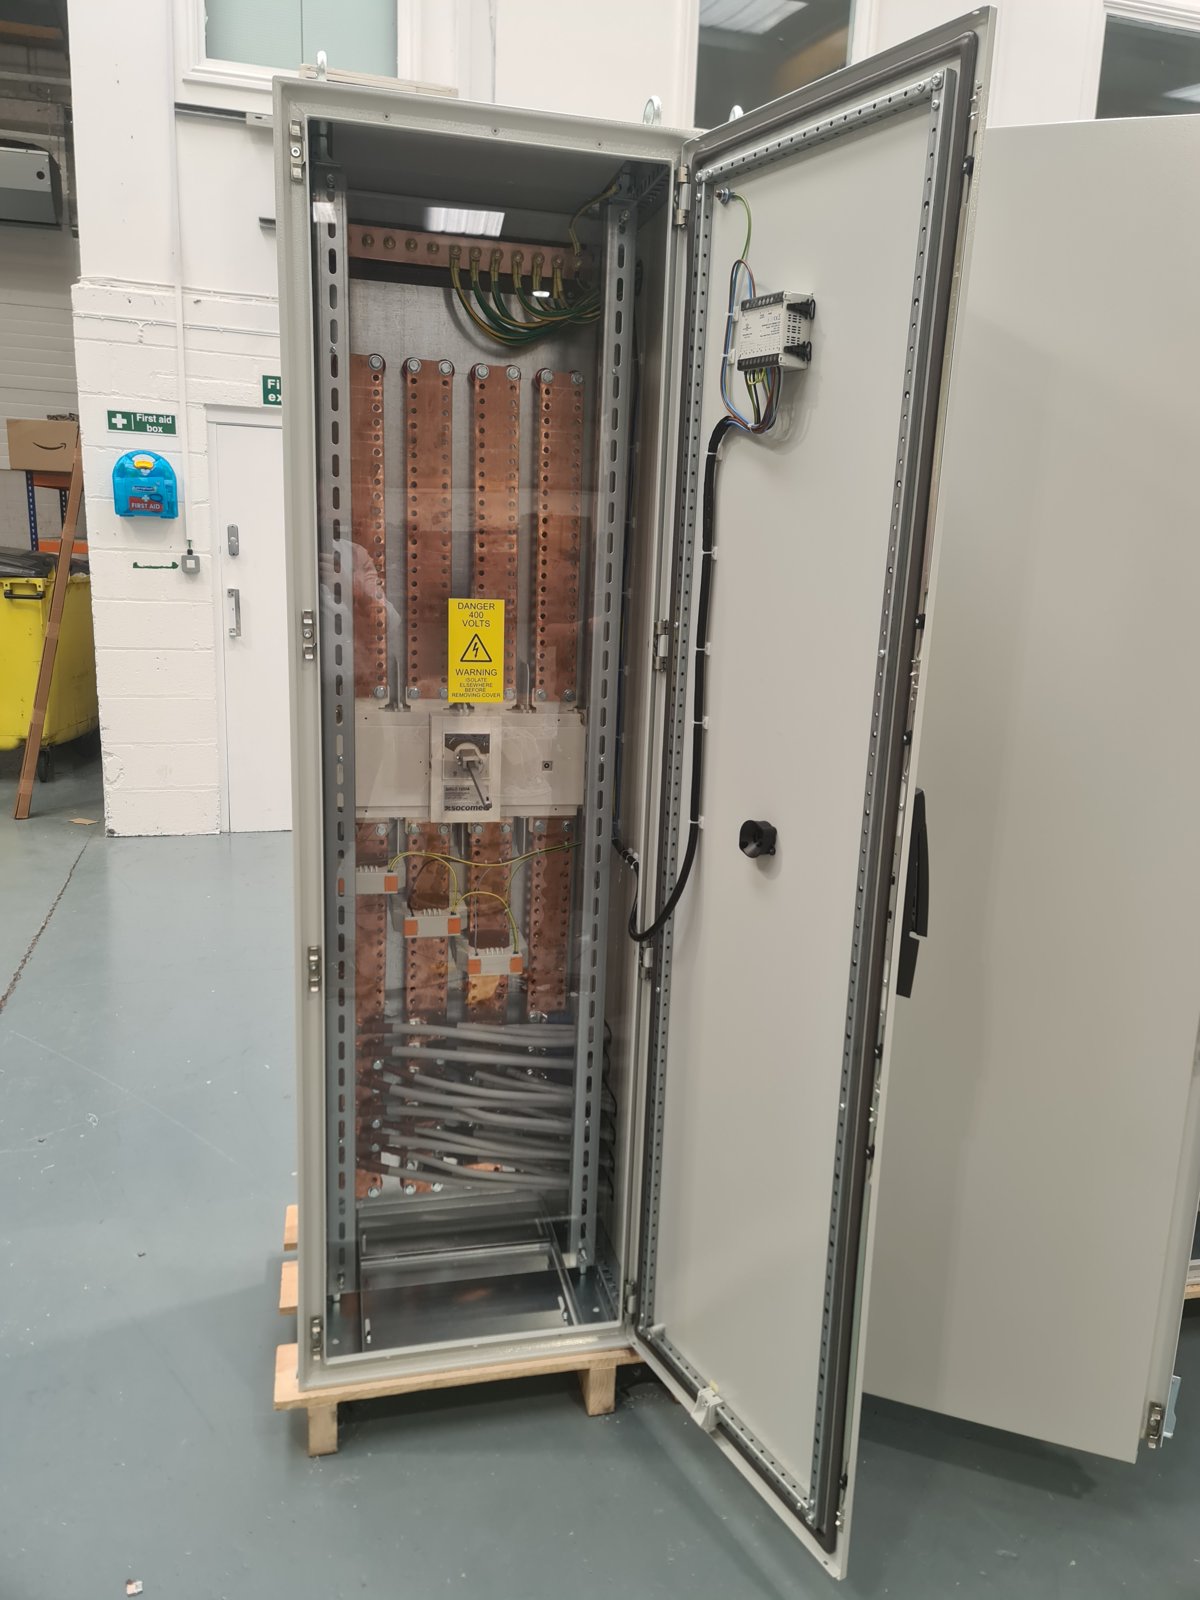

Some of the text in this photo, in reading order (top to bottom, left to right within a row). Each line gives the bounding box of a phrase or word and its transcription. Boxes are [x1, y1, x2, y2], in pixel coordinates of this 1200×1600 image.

[136, 413, 172, 424] First aid
[146, 423, 163, 433] box
[457, 602, 495, 610] DANGER
[468, 611, 484, 619] 400
[462, 619, 491, 628] VOLTS
[455, 668, 498, 676] WARNING
